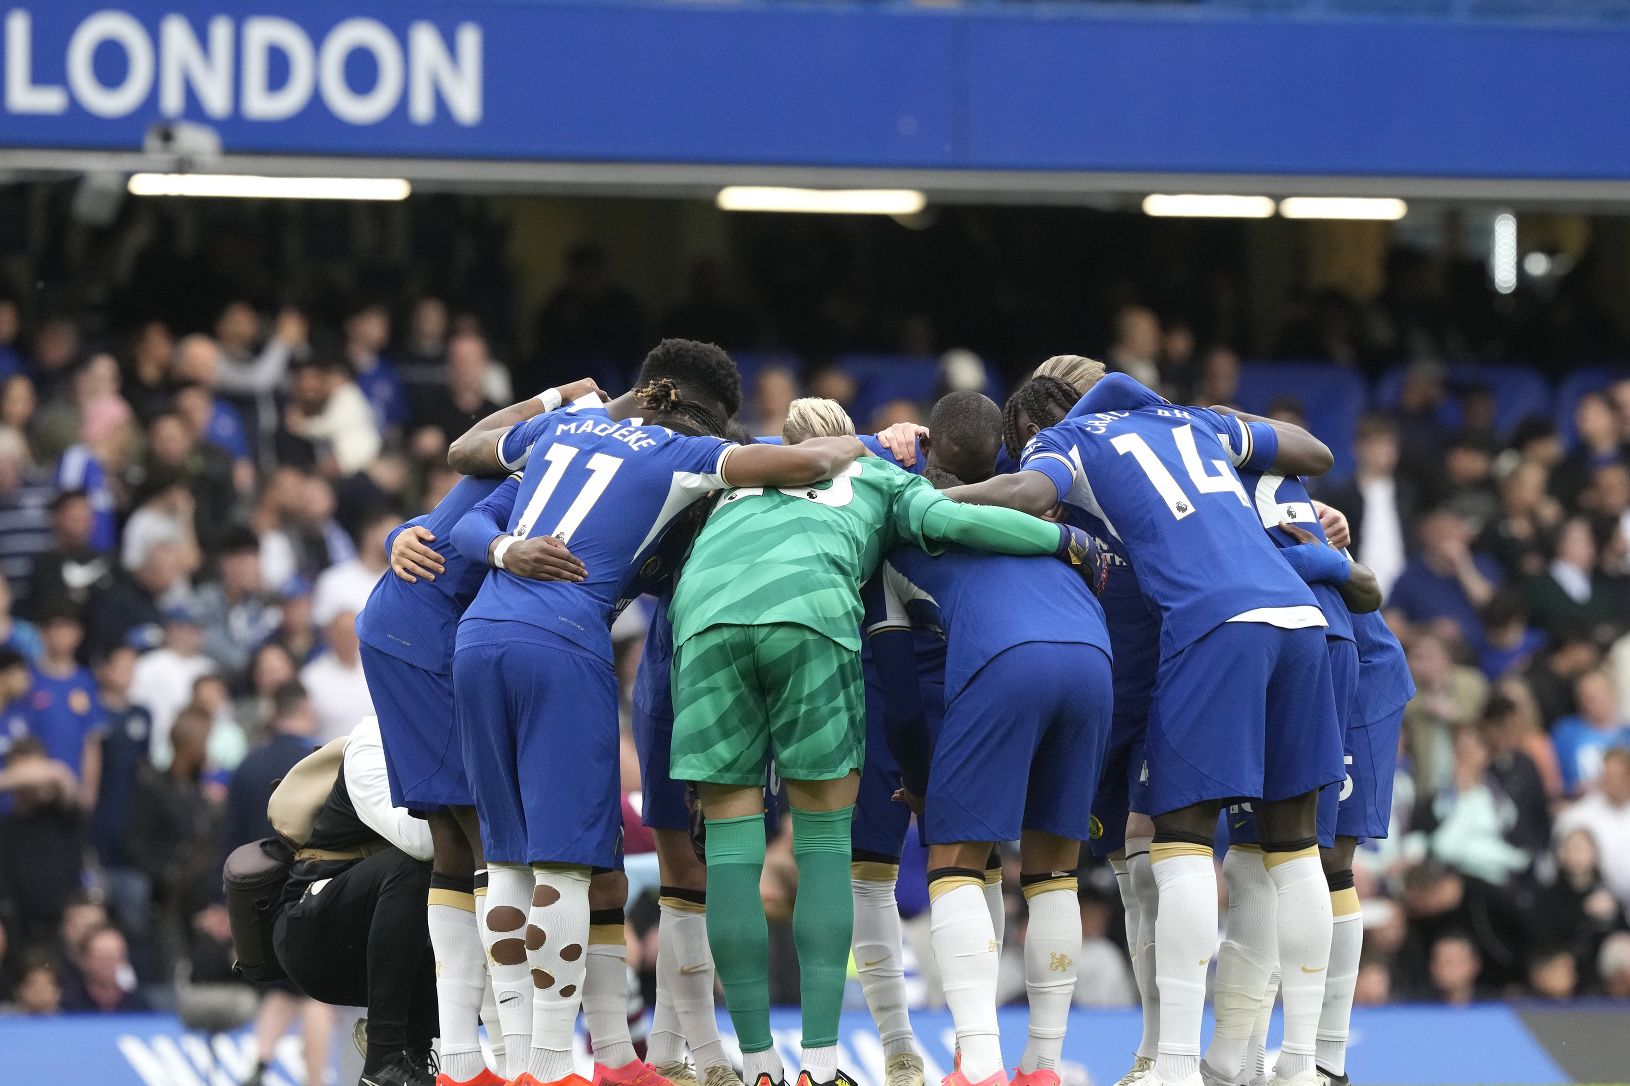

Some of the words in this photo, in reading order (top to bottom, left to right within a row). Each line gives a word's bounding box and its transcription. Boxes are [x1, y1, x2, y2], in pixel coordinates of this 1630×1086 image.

[5, 9, 484, 127] LONDON
[1084, 409, 1192, 434] CHALAH
[1110, 423, 1252, 521] 14
[513, 442, 625, 546] 11
